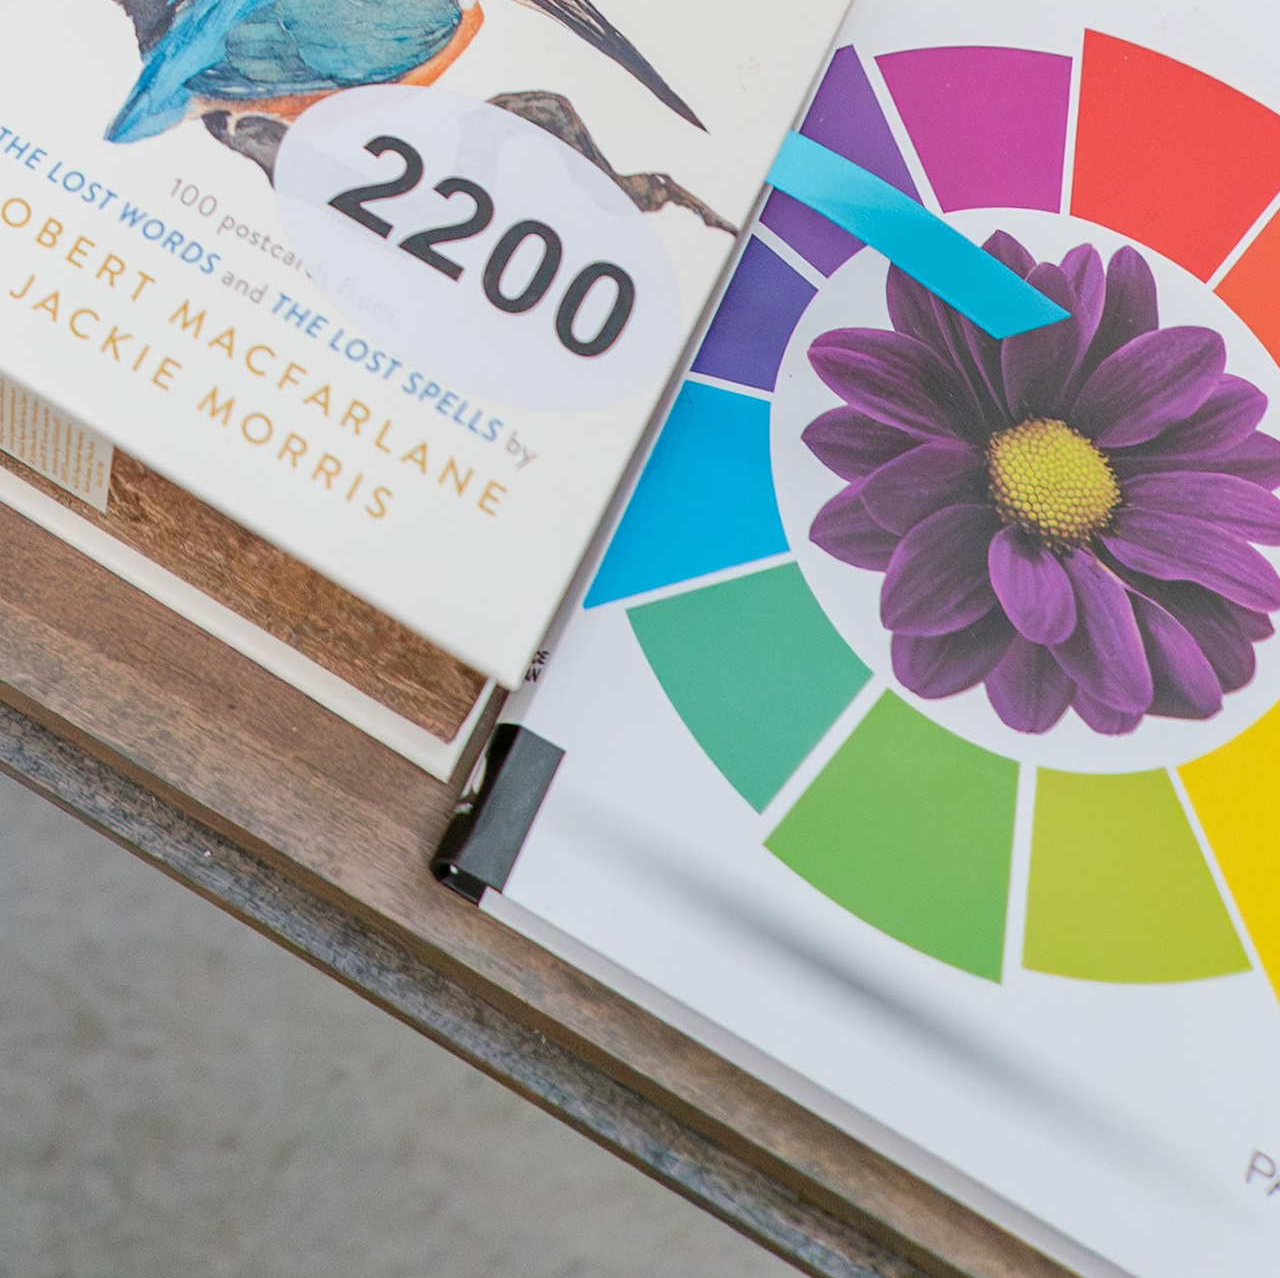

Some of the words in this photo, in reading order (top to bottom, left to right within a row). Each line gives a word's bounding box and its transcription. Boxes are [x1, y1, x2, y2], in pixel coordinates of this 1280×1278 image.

[169, 177, 218, 217] 100
[328, 135, 637, 359] 2200
[9, 274, 183, 392] JACKIE
[197, 387, 395, 522] MORRIS
[47, 159, 119, 212] LOST
[116, 200, 223, 276] WORDS
[221, 269, 270, 305] and
[271, 291, 330, 339] THE
[329, 325, 402, 381] LOST
[400, 370, 507, 445] SPELLS
[505, 429, 540, 471] by
[168, 297, 508, 519] MACFARLANE
